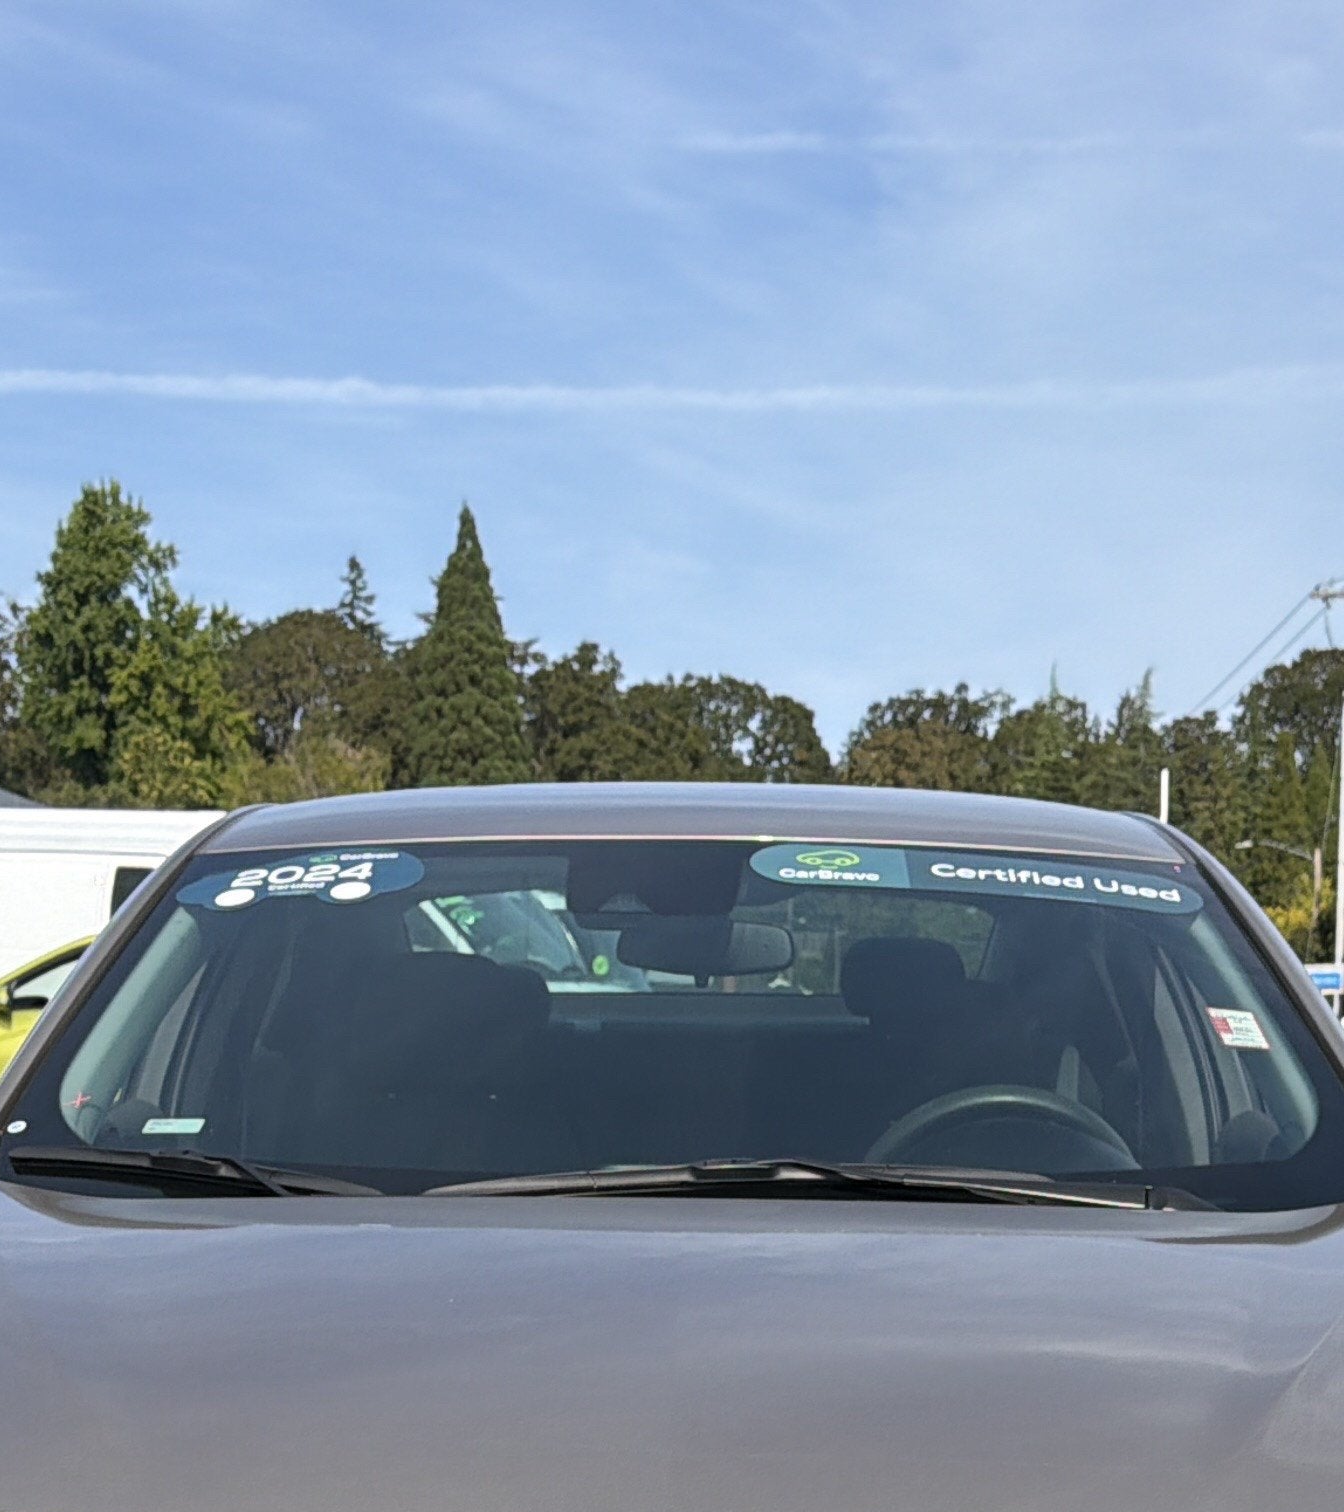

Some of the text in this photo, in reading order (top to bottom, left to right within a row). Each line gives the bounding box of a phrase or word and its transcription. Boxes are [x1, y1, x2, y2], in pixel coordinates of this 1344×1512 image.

[230, 862, 373, 888] 2024
[779, 867, 880, 882] CarBravo
[930, 862, 1182, 903] Certified Used
